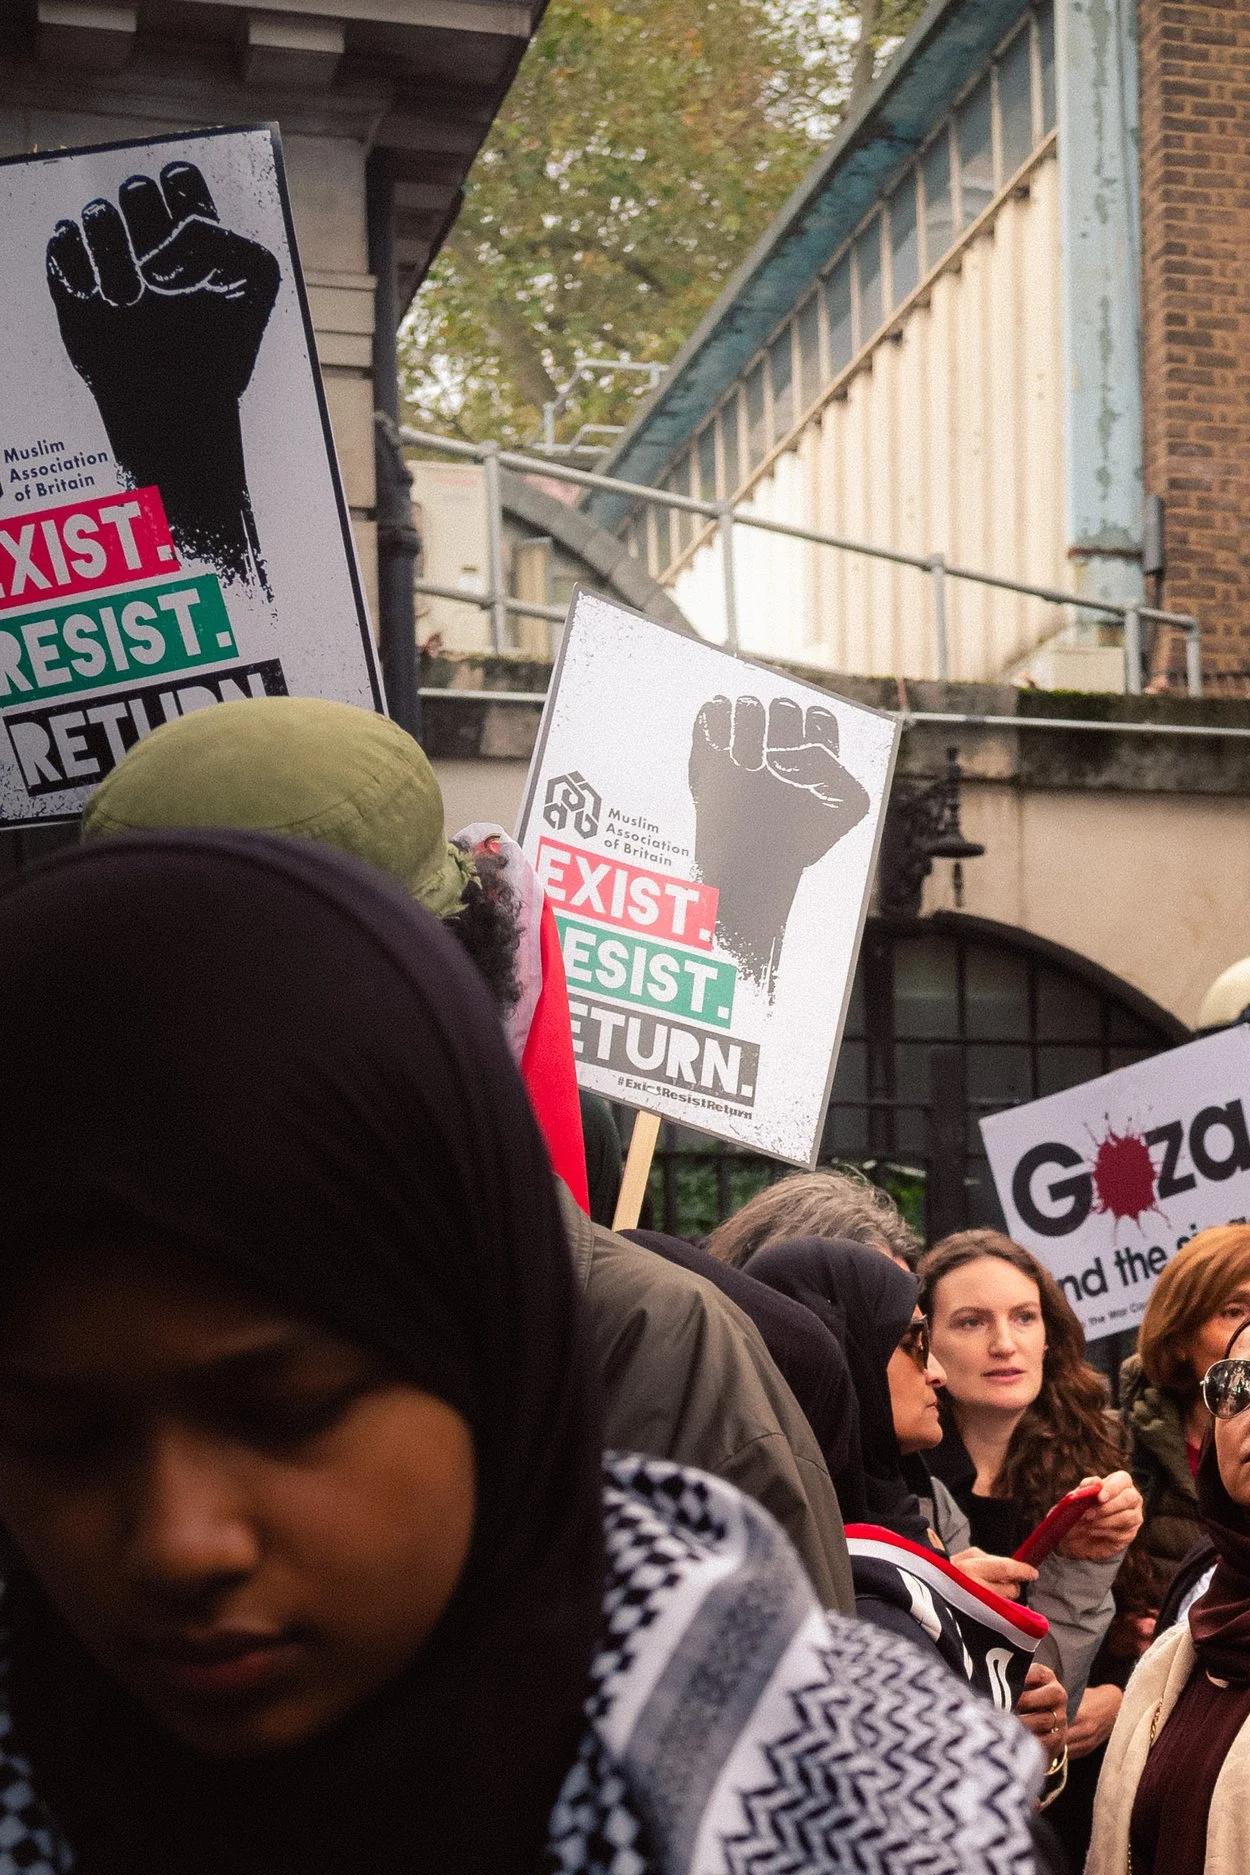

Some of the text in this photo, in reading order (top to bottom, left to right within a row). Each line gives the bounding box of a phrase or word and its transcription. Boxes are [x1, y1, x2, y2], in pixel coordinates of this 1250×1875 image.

[4, 439, 65, 464] Muslim
[10, 452, 108, 483] Association
[15, 473, 95, 501] of Britain
[0, 501, 173, 598] XIST.
[608, 808, 659, 834] Muslim
[604, 838, 672, 867] of Britain
[605, 822, 689, 857] Association
[537, 843, 712, 942] EXIST.
[563, 926, 730, 1020] ESIST.
[569, 999, 753, 1098] TURN.
[1058, 1246, 1167, 1301] nd the
